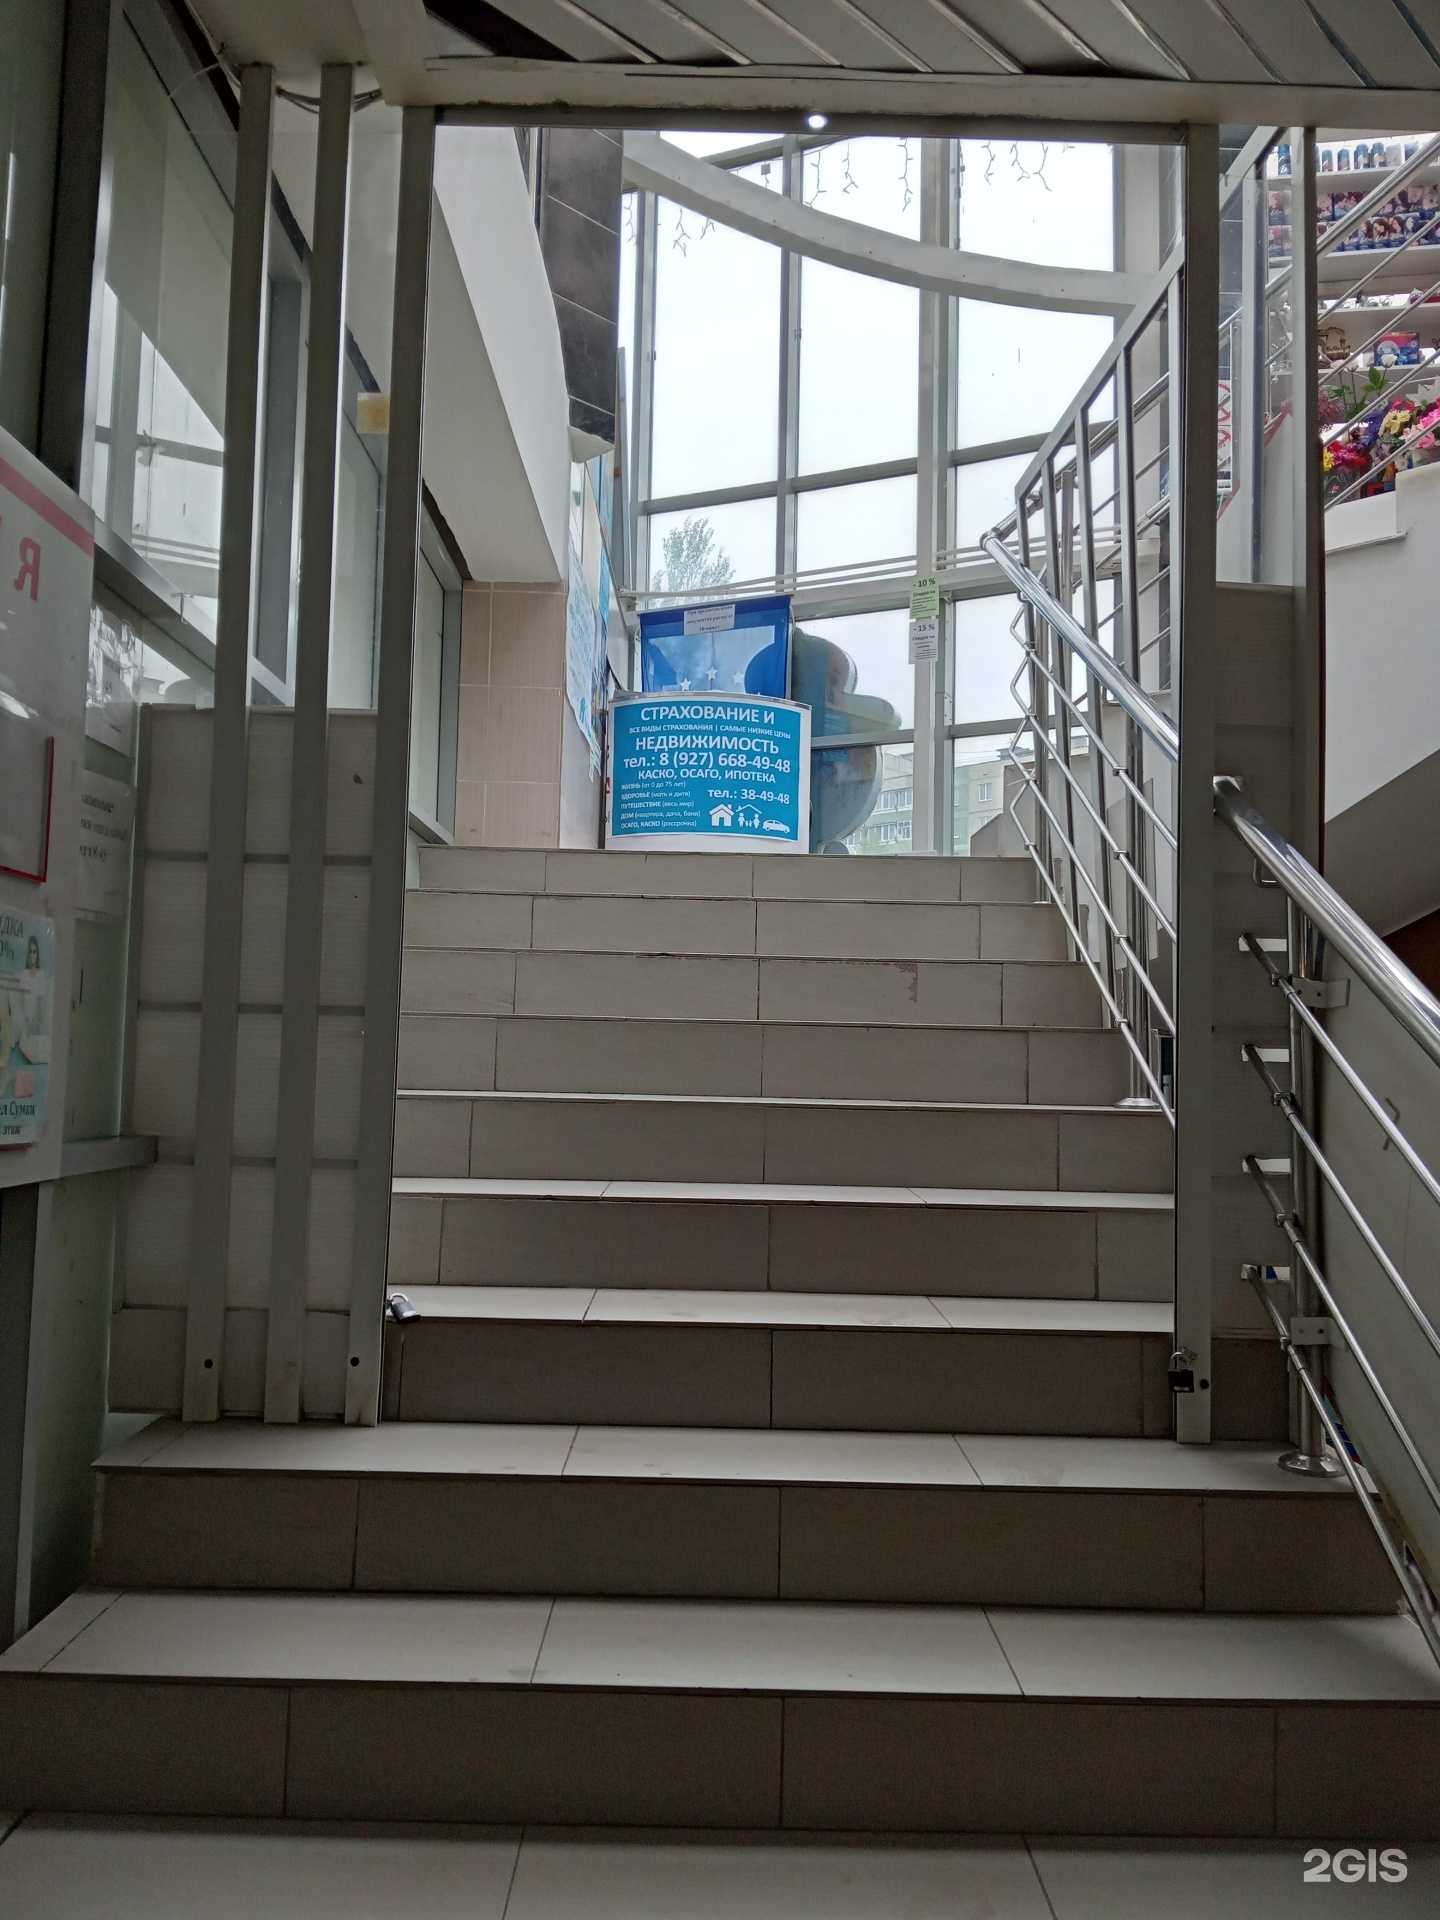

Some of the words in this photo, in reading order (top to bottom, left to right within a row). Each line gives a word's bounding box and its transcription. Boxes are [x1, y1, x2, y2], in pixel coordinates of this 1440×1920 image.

[641, 705, 759, 723] СТРАХОВАНИЕ
[763, 710, 775, 725] И
[662, 723, 713, 731] СТРАХОВАНИЯ
[719, 724, 747, 733] САМЫЕ
[747, 727, 773, 736] НИЗКИЕ
[635, 735, 779, 754] НЕДВИЖИМОСТЬ
[623, 756, 656, 769] тел.:
[659, 752, 669, 766] 8
[673, 751, 714, 769] (927)
[718, 753, 791, 773] 668-49-48
[638, 768, 678, 780] КАСКО,
[680, 767, 722, 780] ОСАГО,
[725, 769, 776, 784] ИПОТЕКА
[707, 789, 737, 799] тел.:
[740, 788, 790, 805] 38-49-48
[0, 916, 24, 938] ДКА
